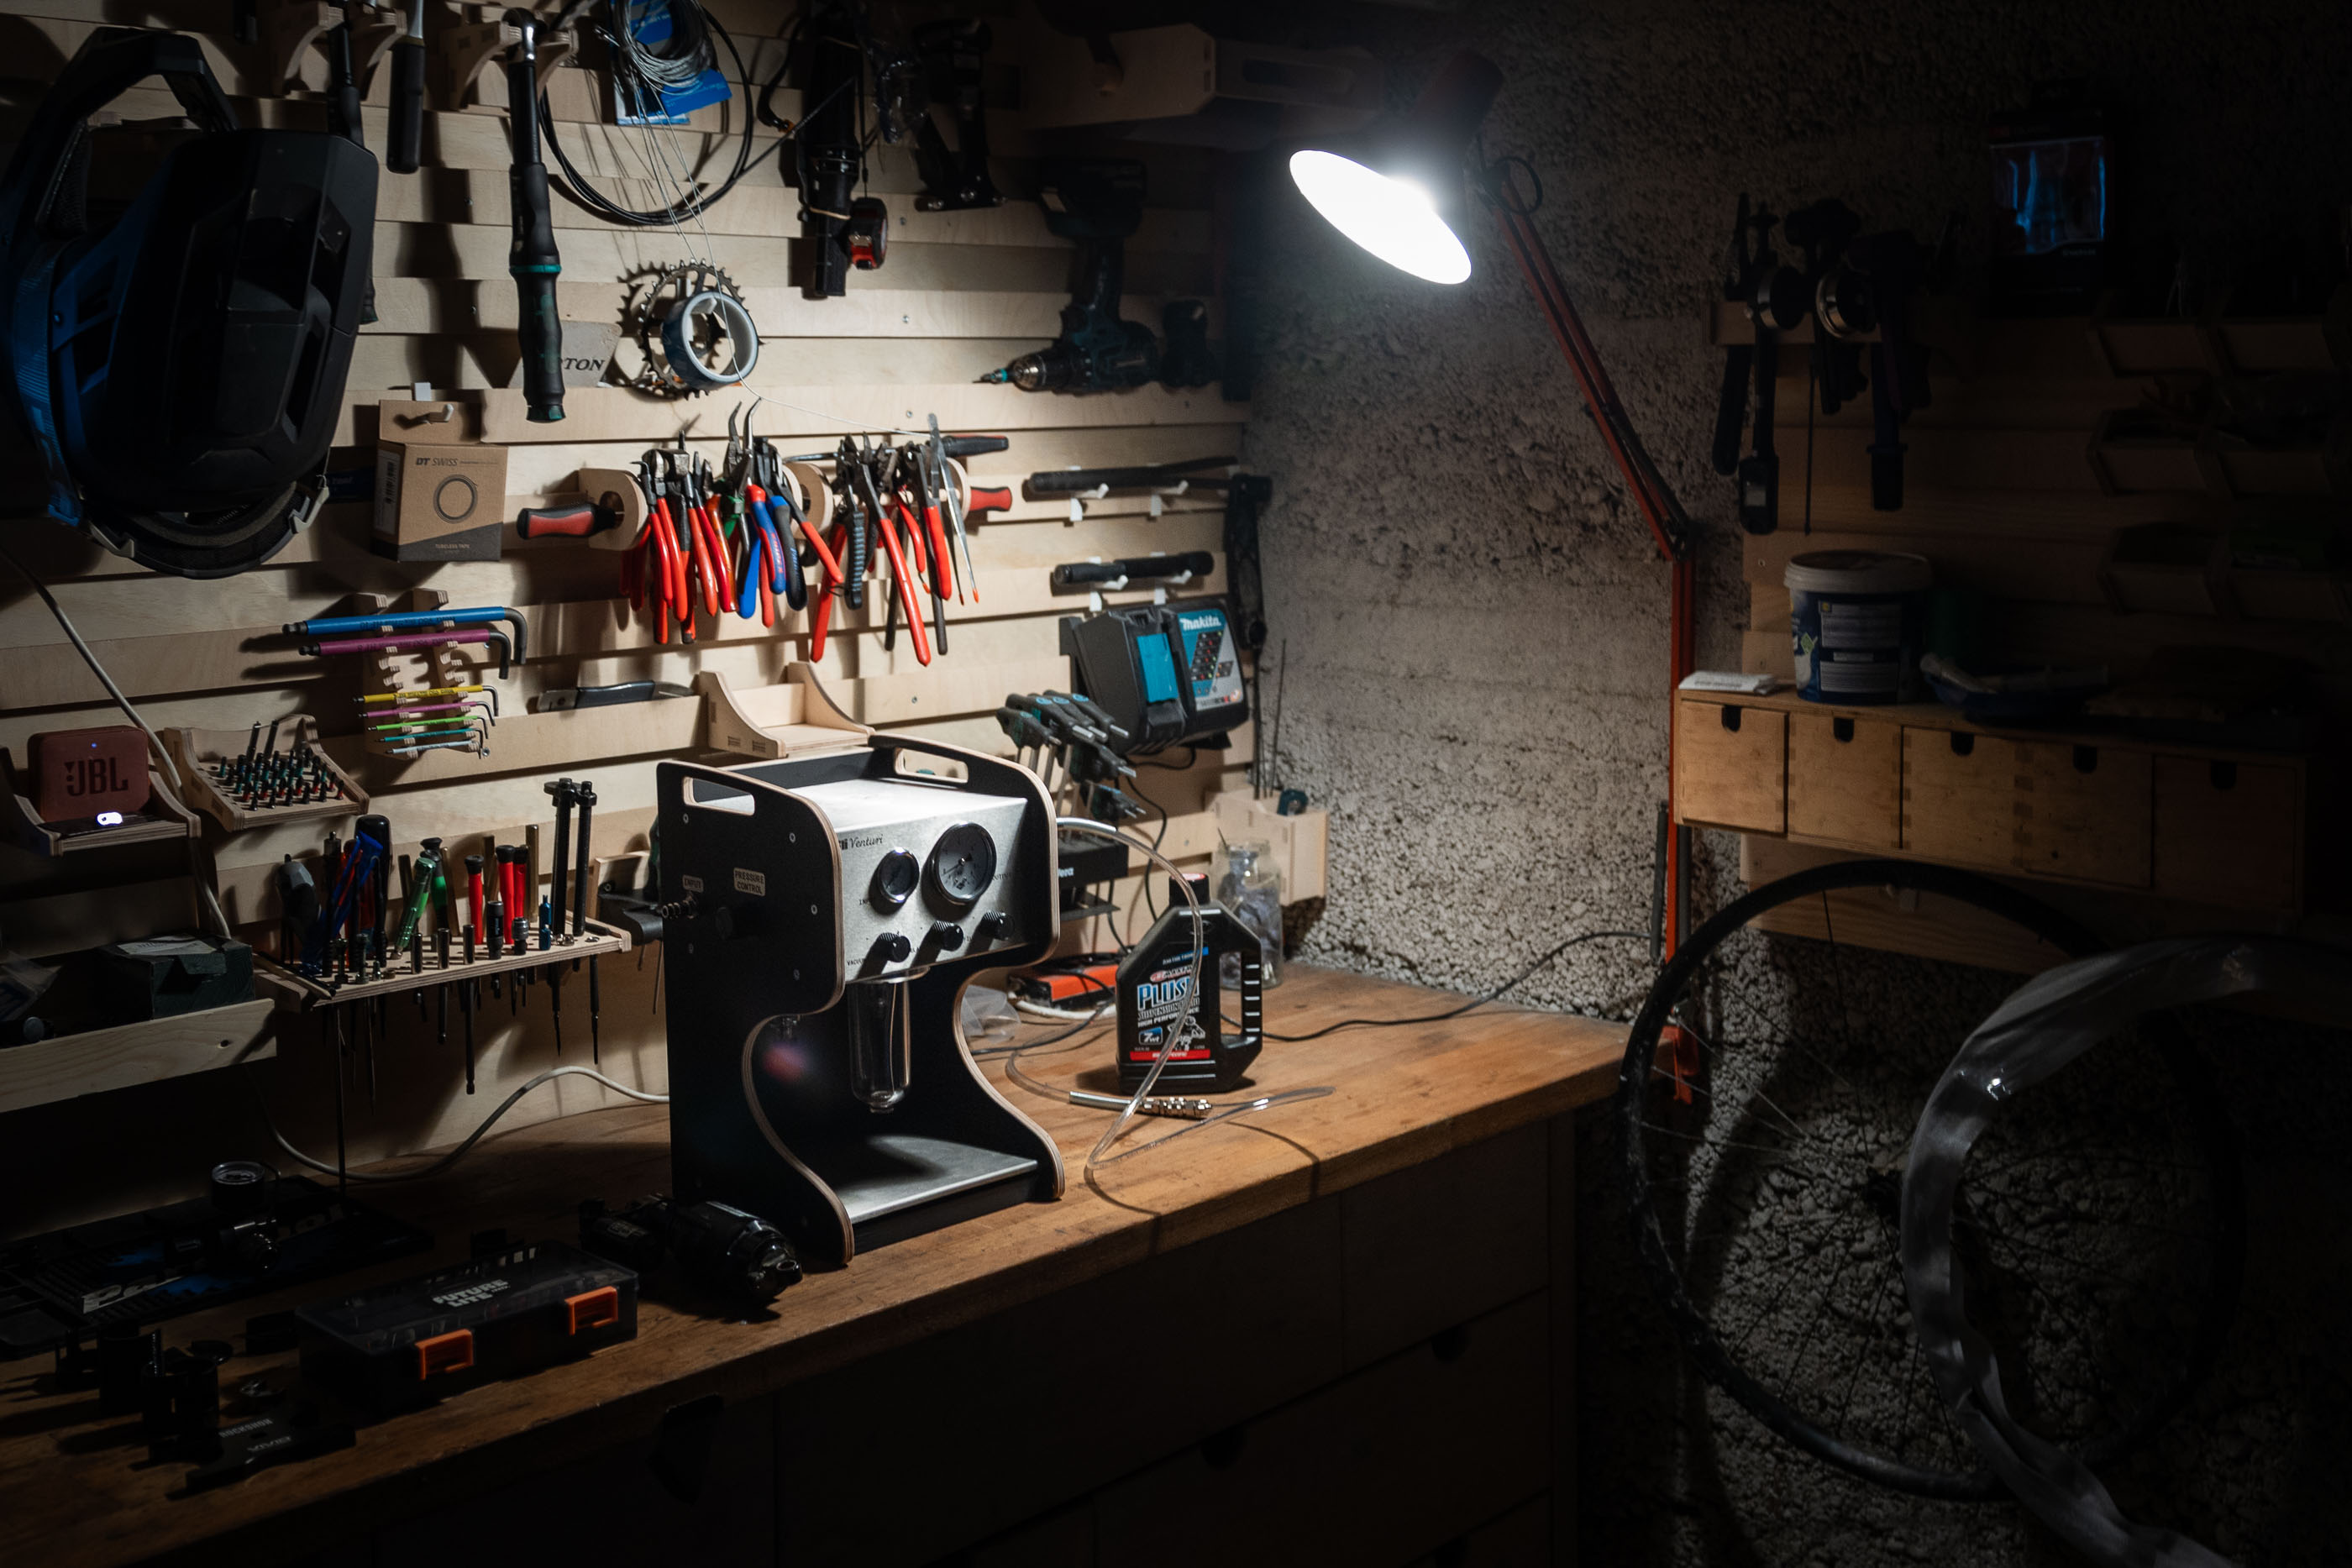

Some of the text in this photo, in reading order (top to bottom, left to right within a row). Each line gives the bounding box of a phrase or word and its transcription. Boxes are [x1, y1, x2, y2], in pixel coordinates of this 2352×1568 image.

[432, 458, 459, 466] SWISS
[66, 758, 129, 796] JBL
[734, 870, 764, 884] PRESSURE
[738, 881, 763, 894] CONTROL
[432, 1278, 509, 1304] FUTURE
